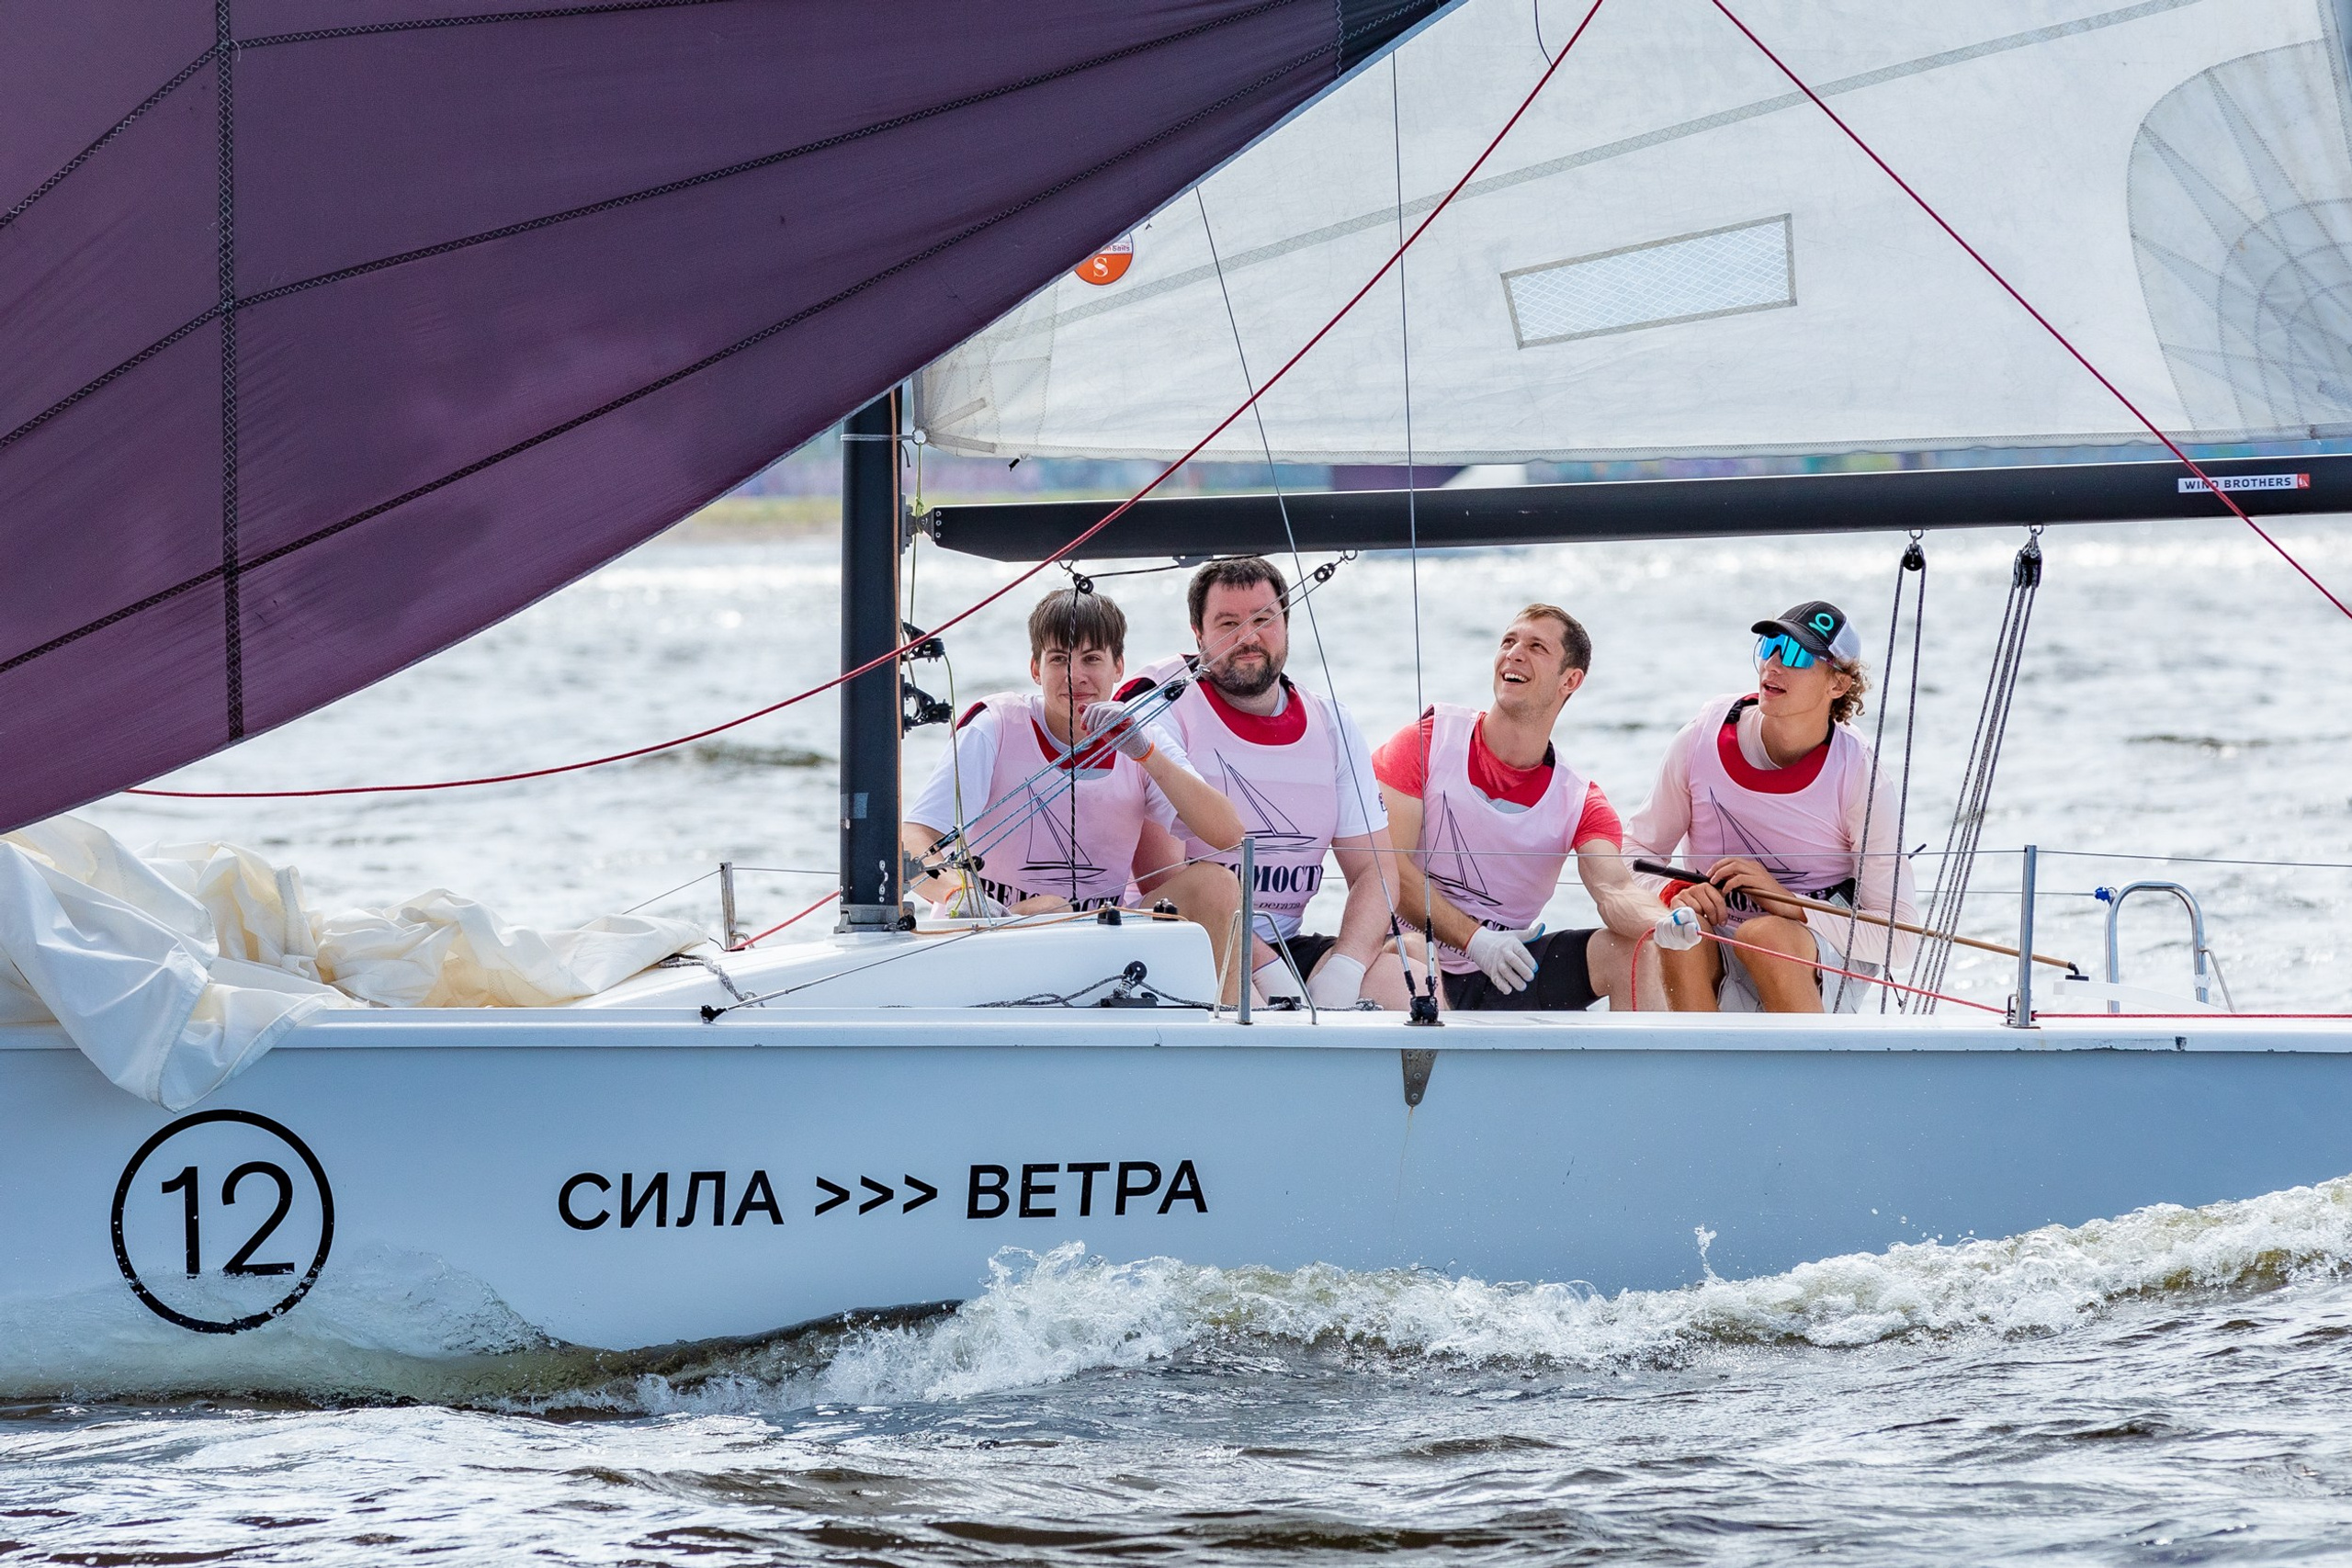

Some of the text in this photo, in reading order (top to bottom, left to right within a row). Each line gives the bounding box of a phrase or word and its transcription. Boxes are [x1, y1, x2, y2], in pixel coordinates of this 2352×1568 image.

[1092, 256, 1109, 278] S
[2223, 477, 2291, 489] BROTHERS
[558, 1169, 785, 1230] СИЛА
[967, 1159, 1208, 1220] ВЕТРА
[161, 1160, 295, 1279] 12
